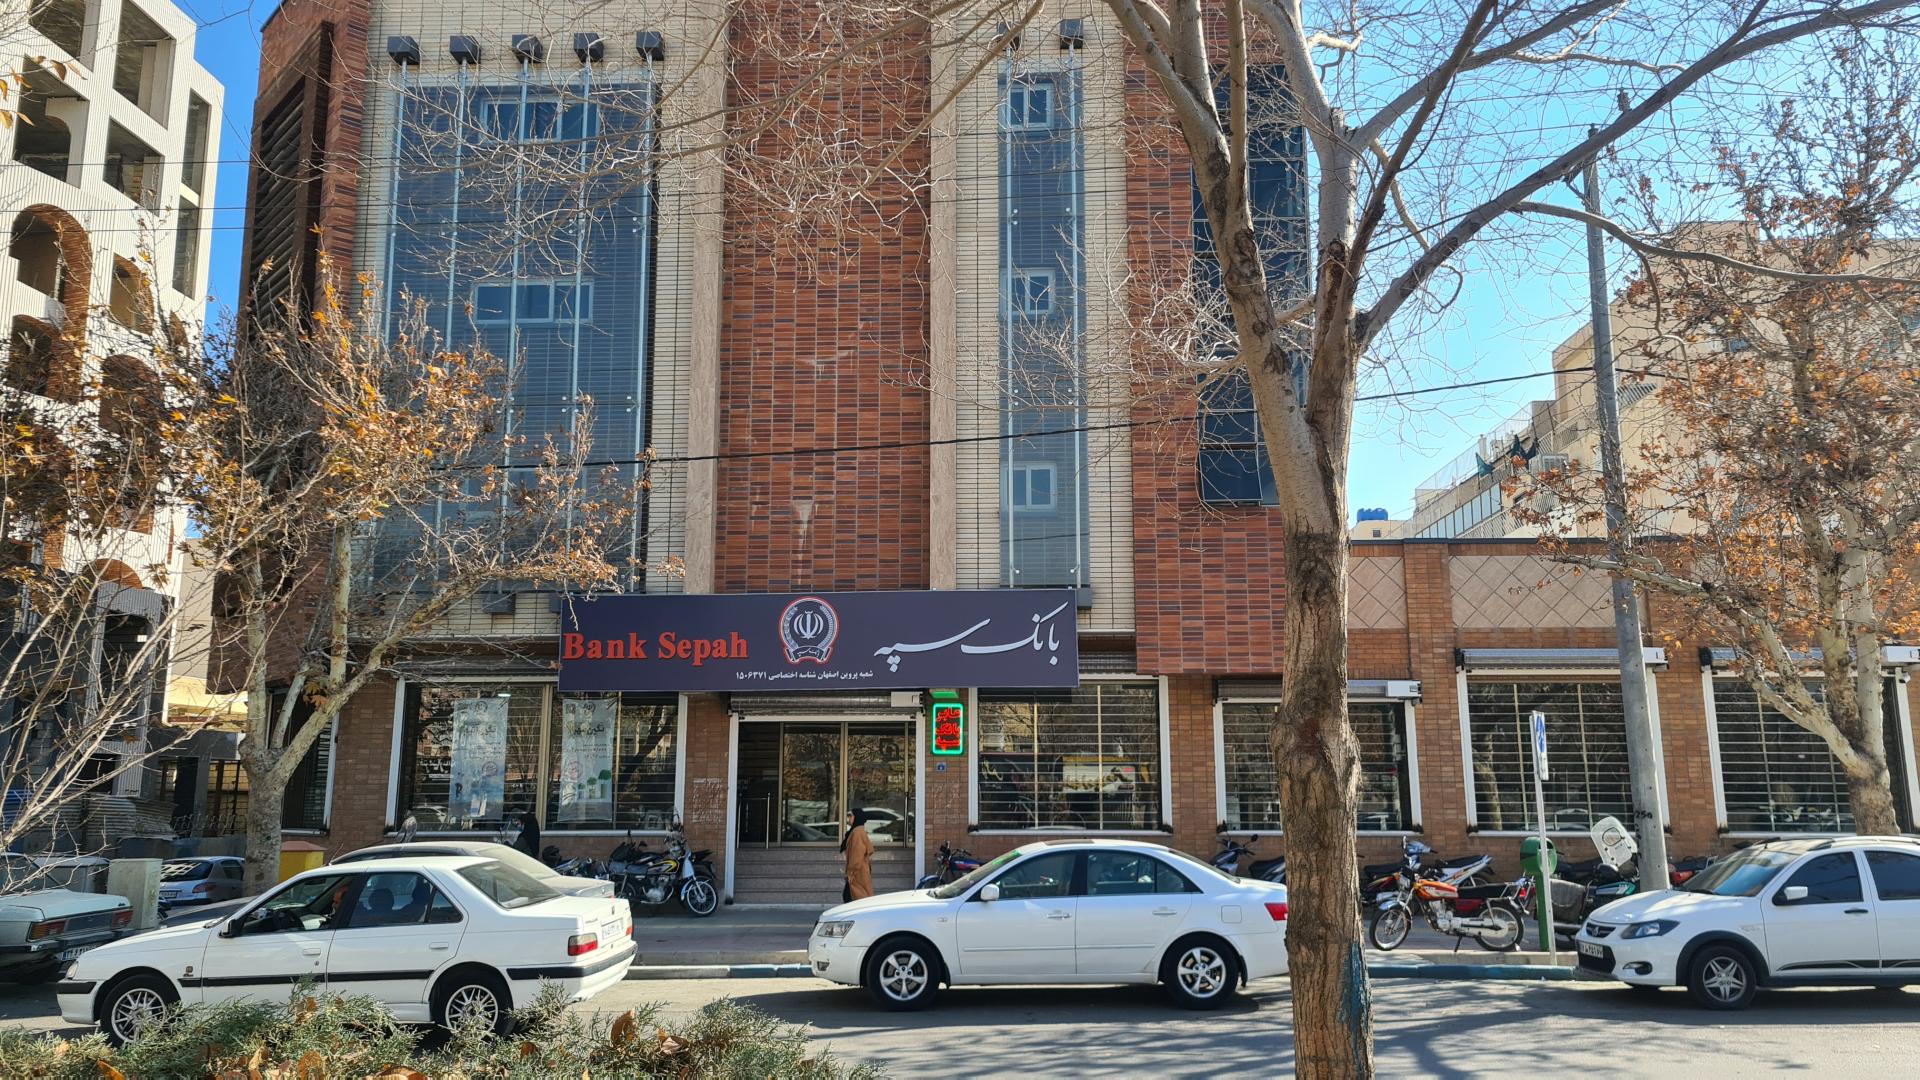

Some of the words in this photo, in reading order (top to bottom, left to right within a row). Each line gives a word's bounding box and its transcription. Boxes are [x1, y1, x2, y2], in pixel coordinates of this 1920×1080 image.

[960, 602, 1069, 666] بانک
[563, 632, 647, 660] Bank
[658, 631, 748, 666] Sepah
[873, 618, 991, 673] سپه
[768, 671, 798, 681] اختصاصی
[817, 670, 839, 680] اصفهان
[840, 671, 858, 680] پروین
[858, 670, 874, 678] شعبه
[936, 707, 961, 722] عابر
[935, 722, 961, 737] بانک
[935, 737, 961, 752] سپه
